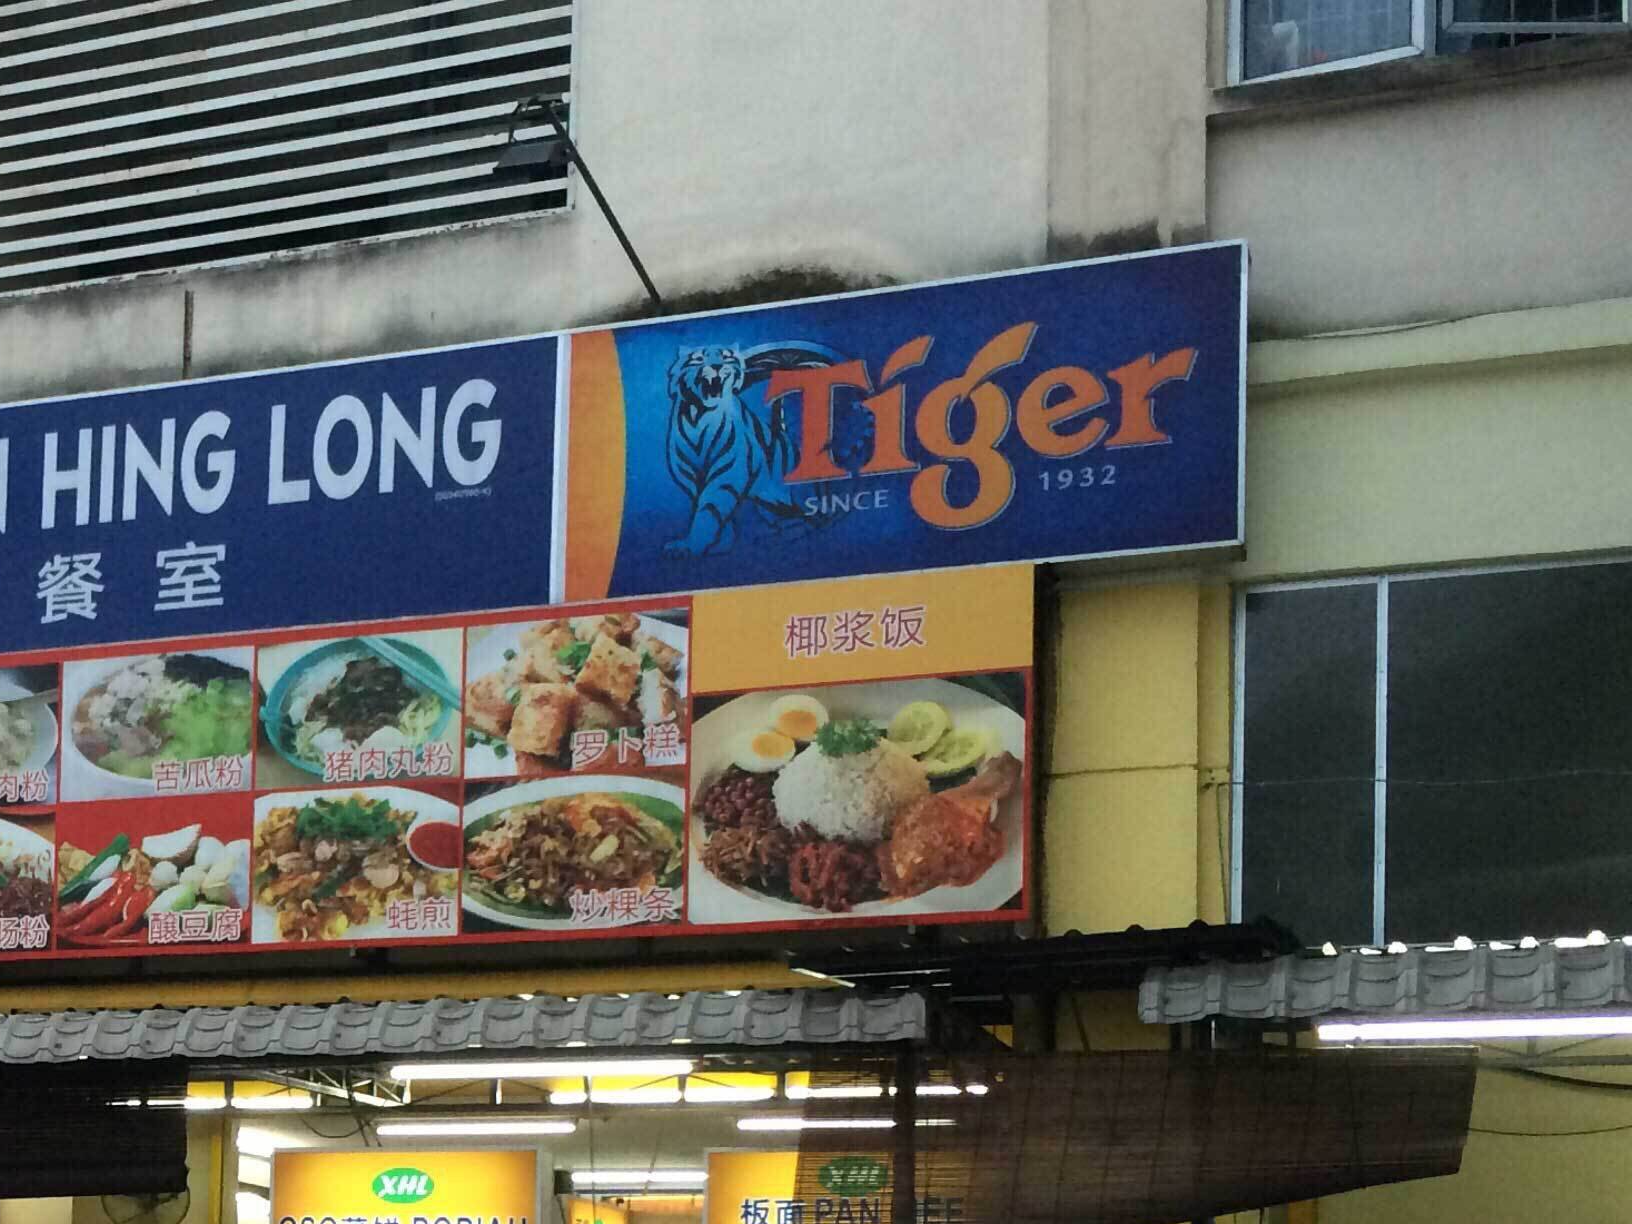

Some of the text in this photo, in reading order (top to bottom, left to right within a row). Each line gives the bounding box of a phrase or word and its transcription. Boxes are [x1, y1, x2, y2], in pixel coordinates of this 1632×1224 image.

[766, 321, 1198, 530] Tiger
[40, 410, 236, 531] HING
[268, 377, 502, 506] LONG
[804, 463, 1118, 516] SINCE 1932
[785, 603, 929, 660] 椰浆饭
[323, 742, 455, 783] 猪肉丸粉
[572, 723, 680, 767] 罗卜糕
[153, 757, 245, 793] 苦瓜粉
[386, 896, 454, 930] 蚝煎
[570, 886, 681, 923] 炒粿条
[378, 1174, 428, 1198] XHL
